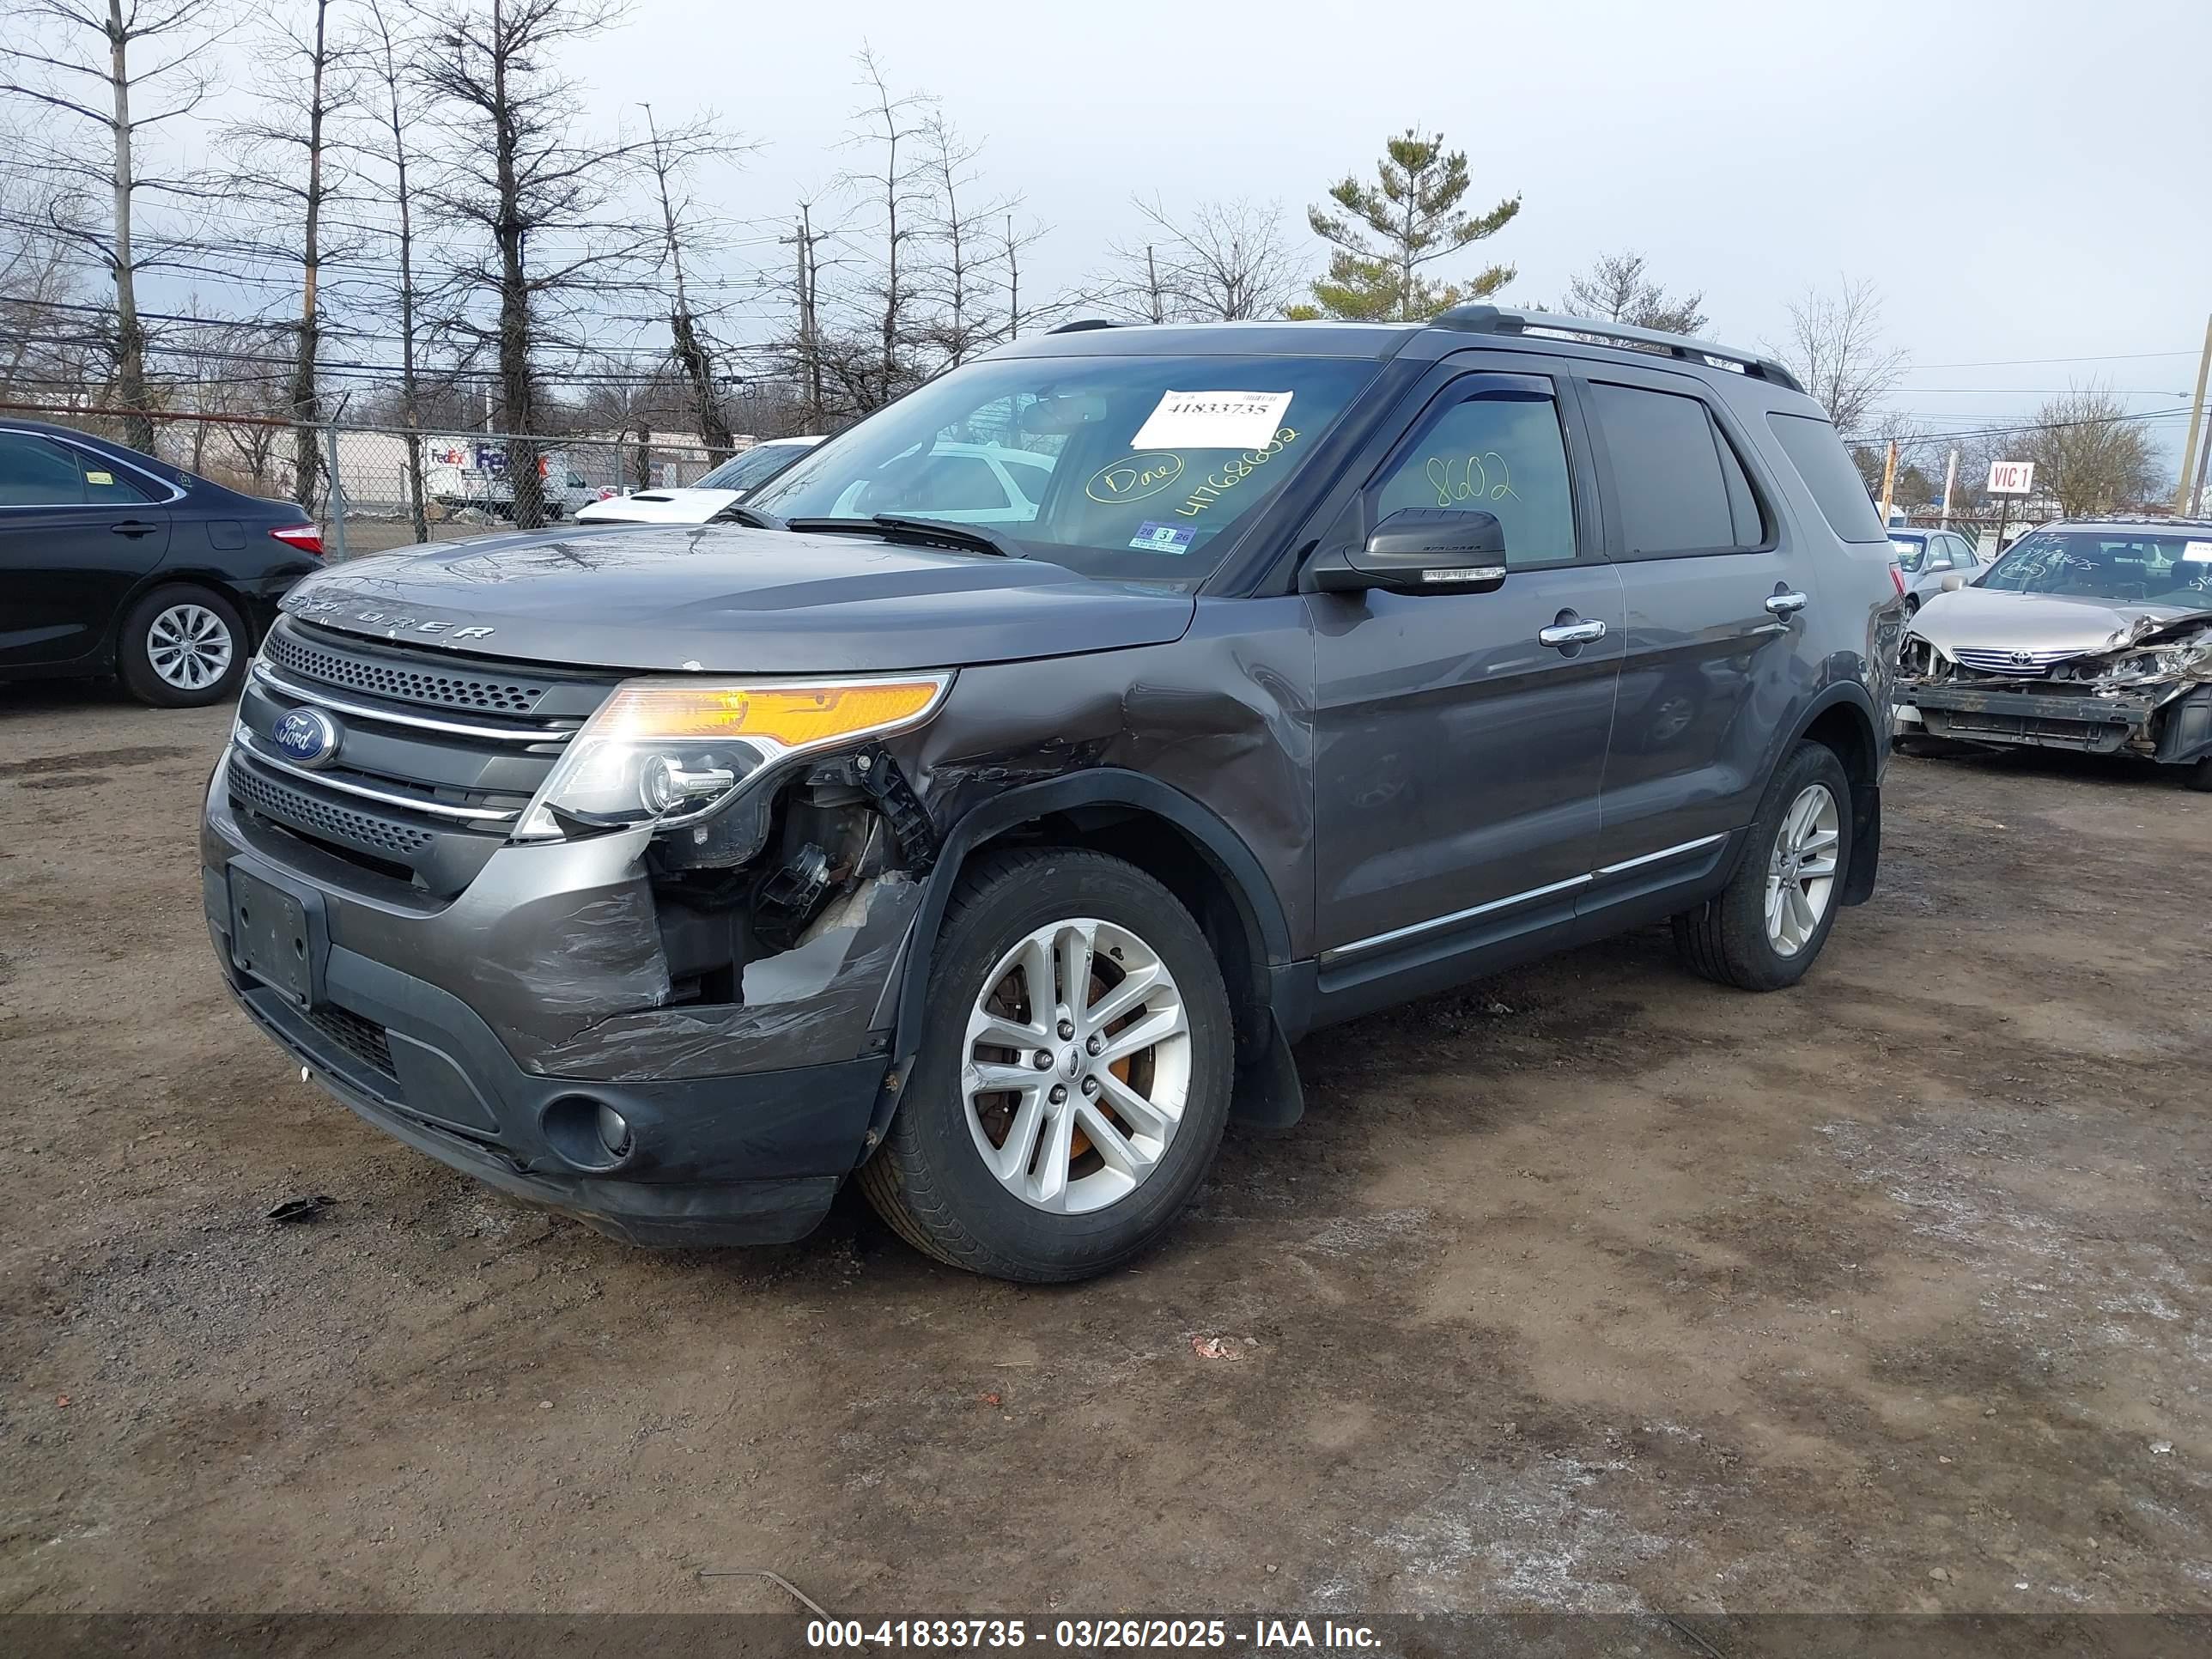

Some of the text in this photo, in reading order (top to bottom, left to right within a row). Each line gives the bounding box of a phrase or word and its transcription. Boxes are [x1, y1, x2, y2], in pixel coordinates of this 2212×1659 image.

[1168, 404, 1269, 415] 41833735
[432, 447, 465, 465] FedEx
[1105, 465, 1166, 493] Done
[1176, 428, 1301, 516] 41768602
[1426, 452, 1522, 507] 8602
[1995, 466, 2028, 488] VIC 1
[1159, 530, 1170, 540] 3
[1176, 533, 1191, 542] 26
[276, 714, 314, 750] Ford
